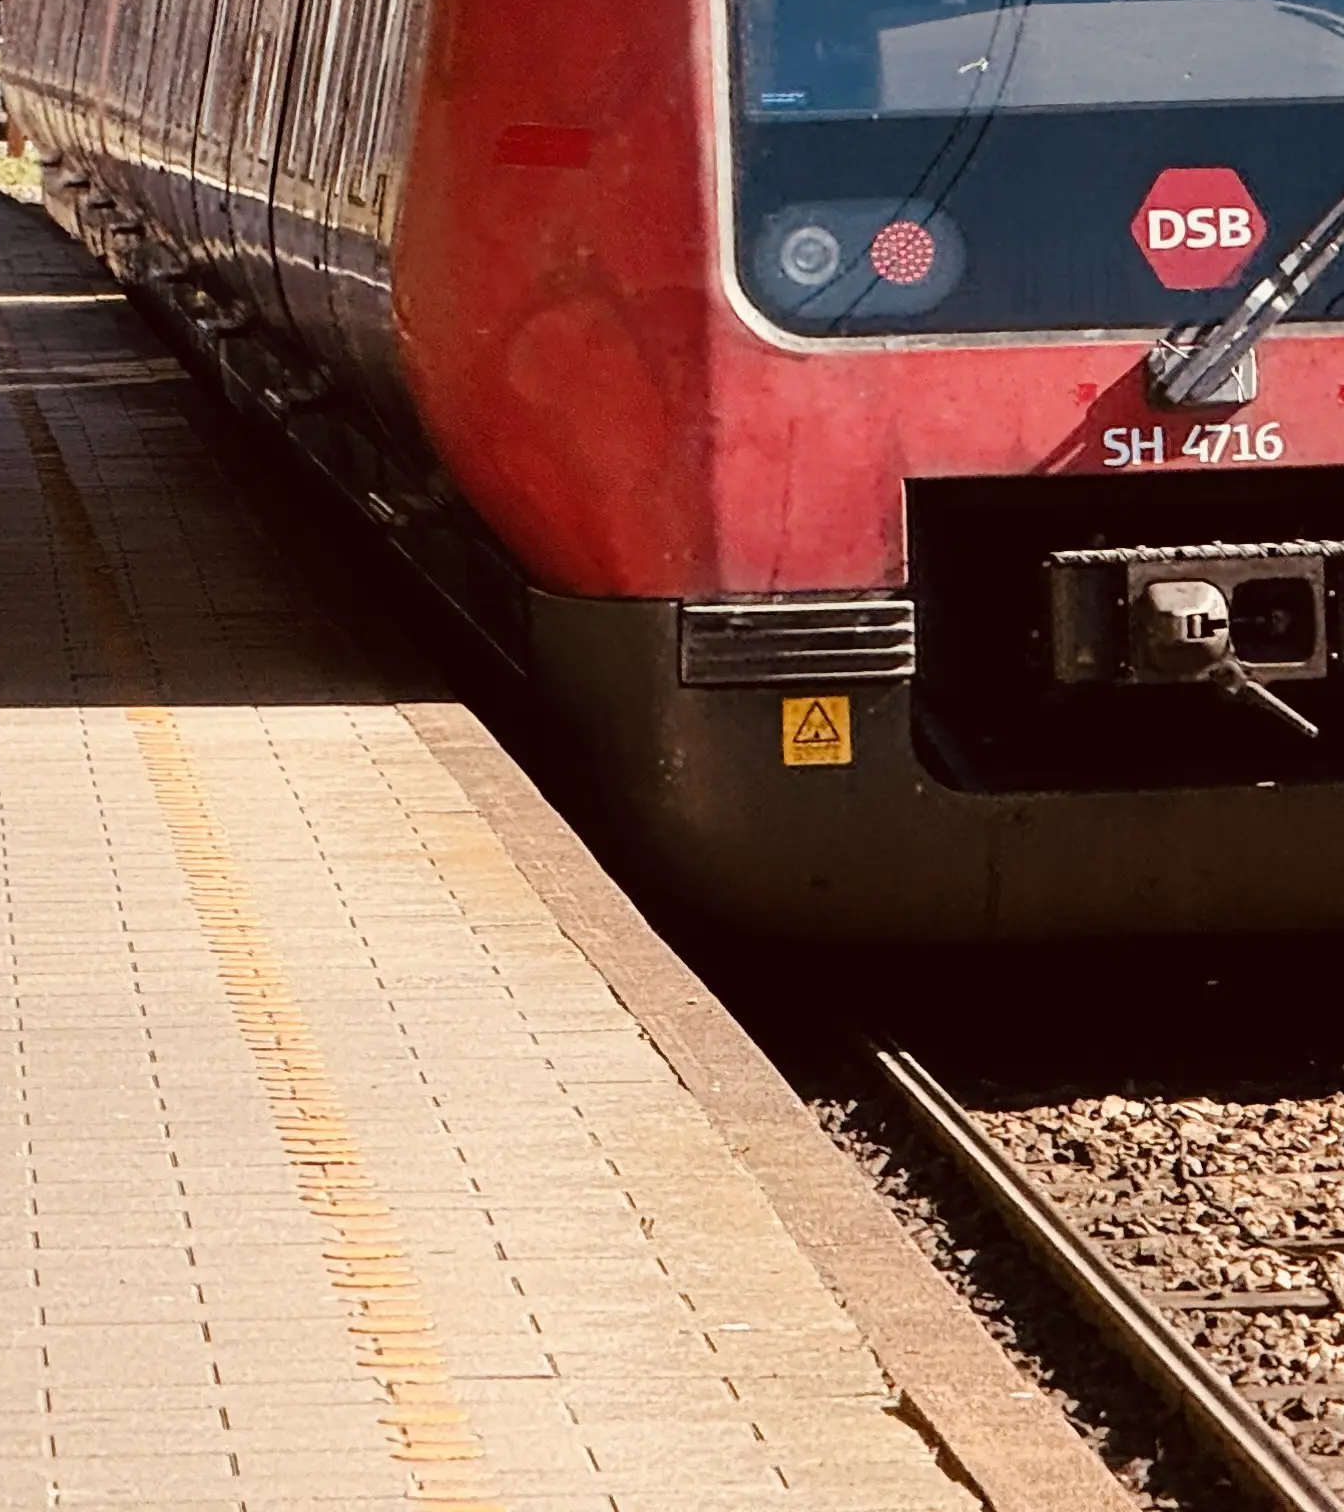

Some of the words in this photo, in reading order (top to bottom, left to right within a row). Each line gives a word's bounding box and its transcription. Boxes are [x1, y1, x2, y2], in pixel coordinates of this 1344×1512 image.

[1148, 208, 1253, 250] DSB
[1104, 426, 1164, 466] SH
[1182, 422, 1283, 464] 4716
